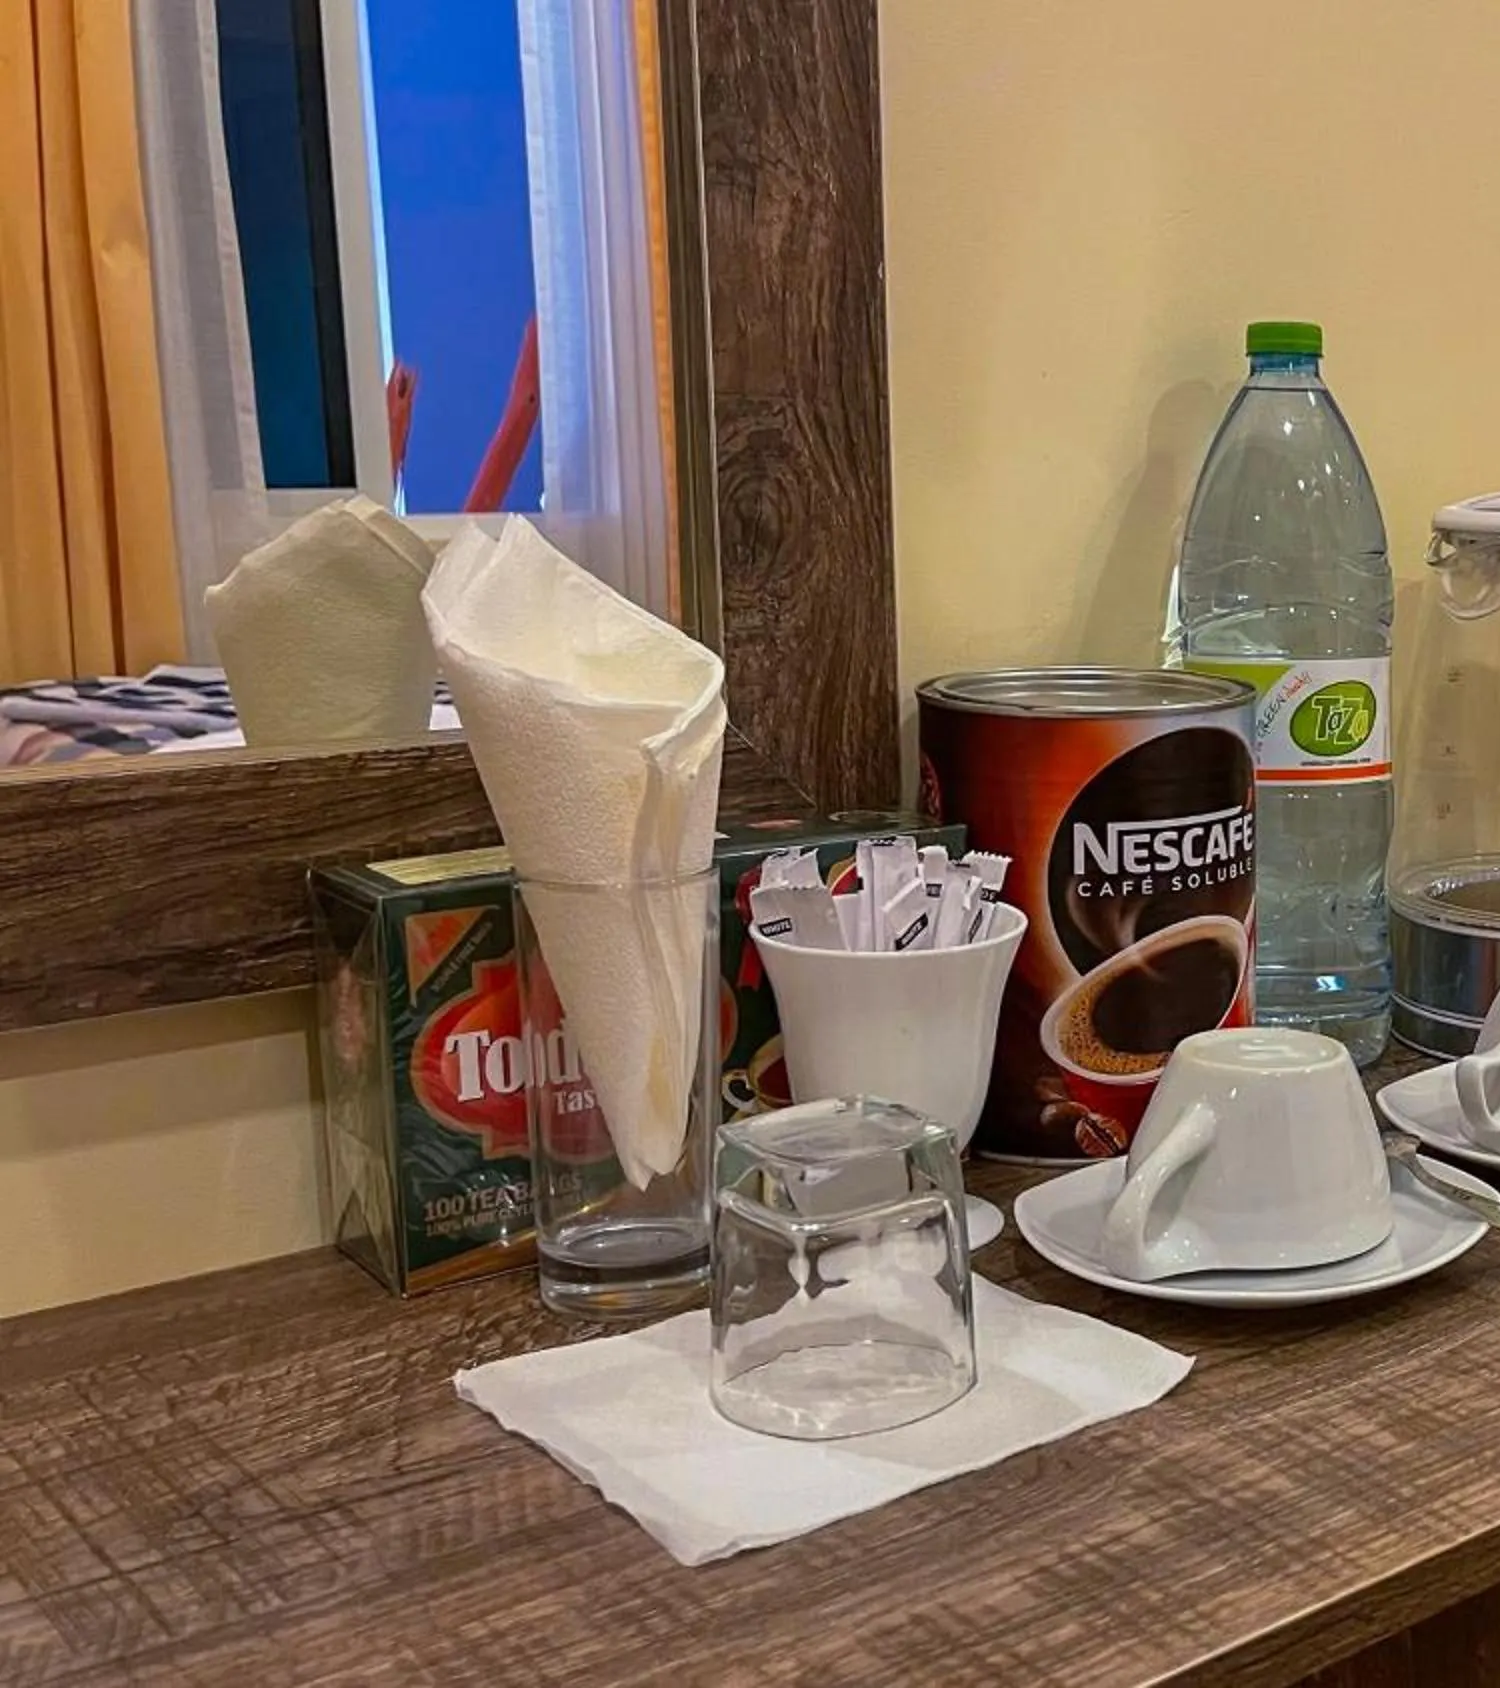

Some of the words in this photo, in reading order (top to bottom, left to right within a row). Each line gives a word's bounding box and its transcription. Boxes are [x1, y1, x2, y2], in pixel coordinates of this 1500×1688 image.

[1077, 876, 1153, 897] CAFÉ
[1171, 857, 1253, 891] SOLUBLE
[424, 1194, 465, 1223] 100
